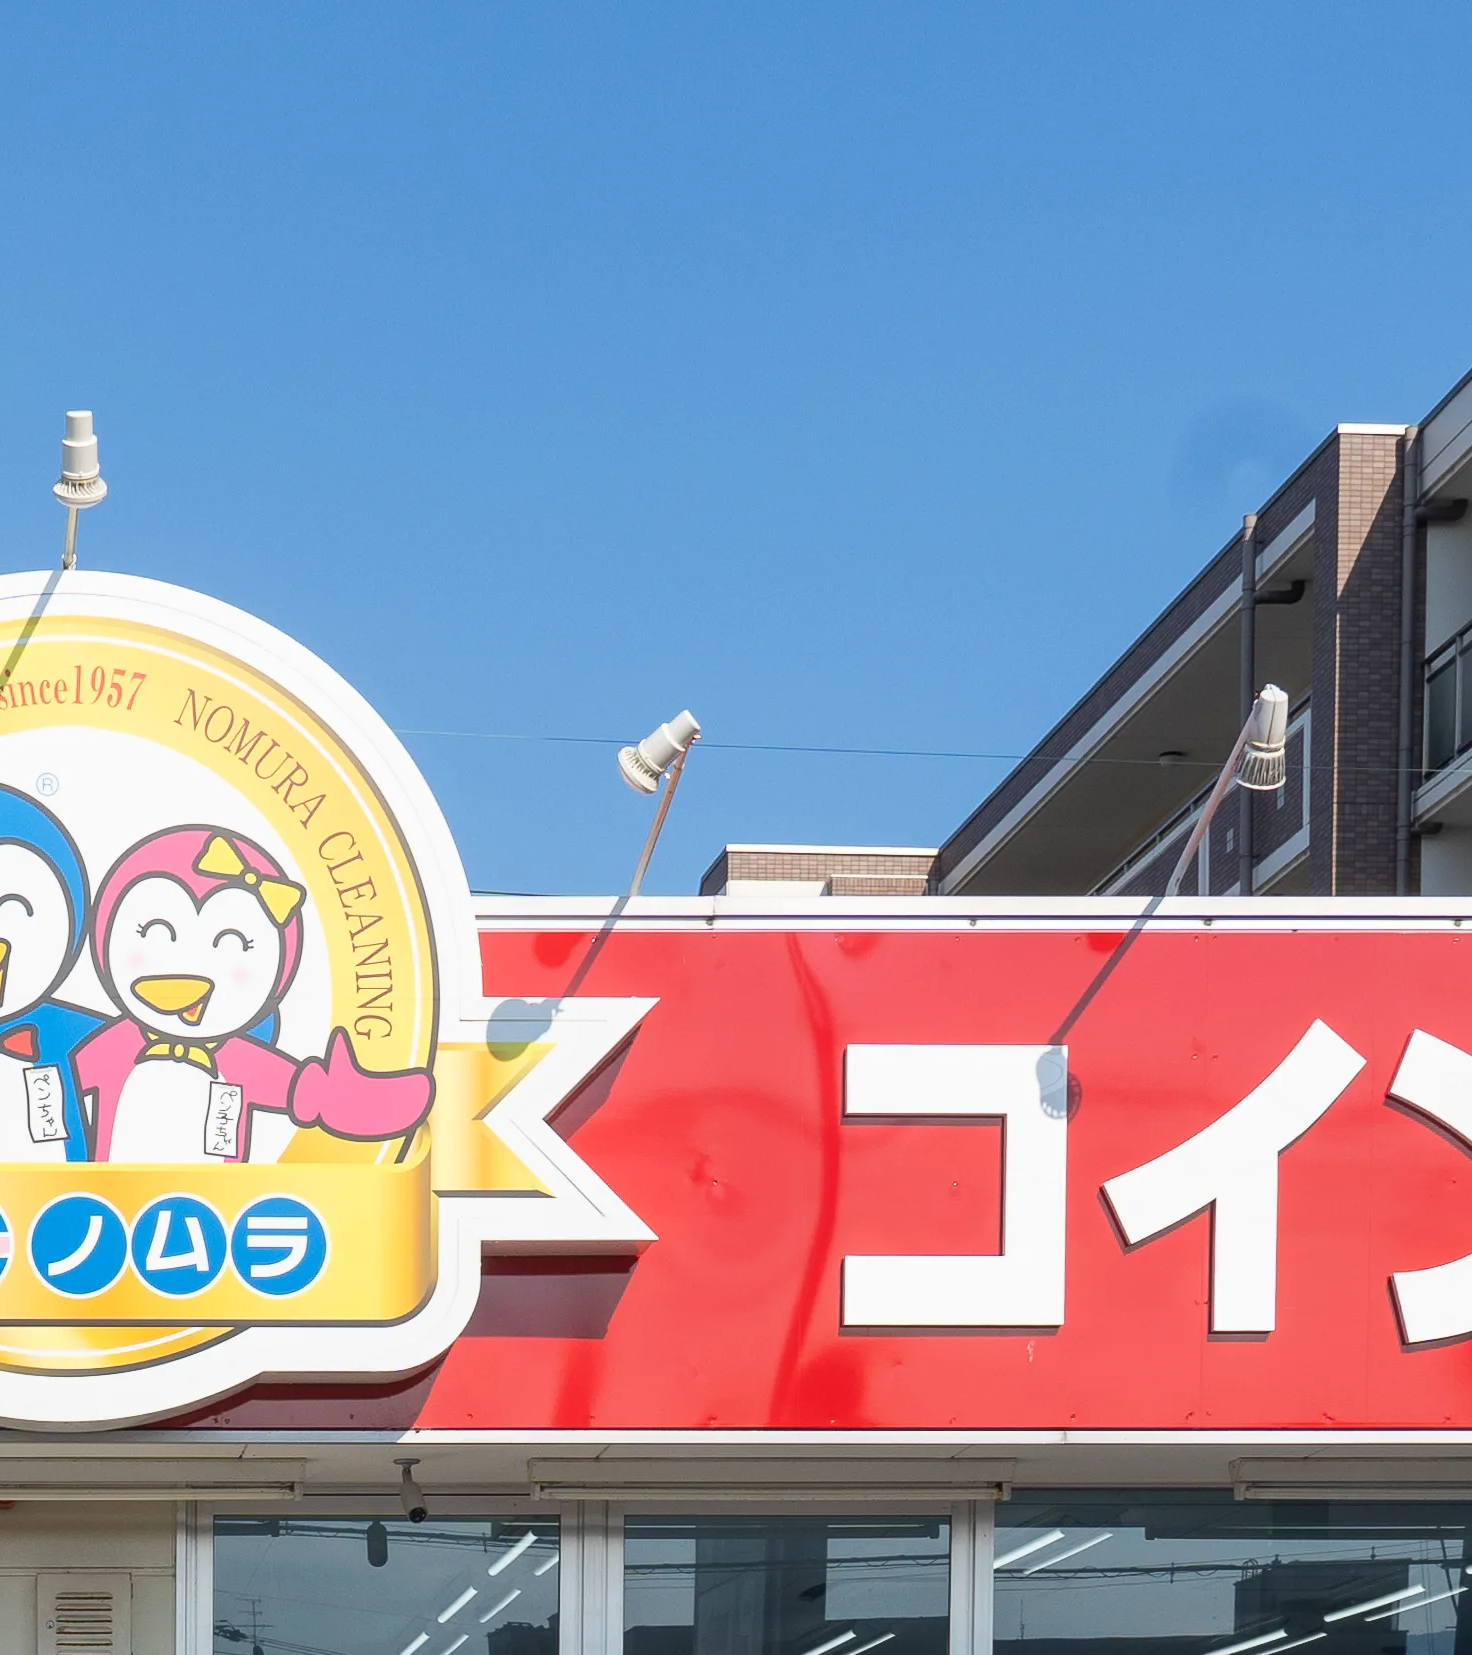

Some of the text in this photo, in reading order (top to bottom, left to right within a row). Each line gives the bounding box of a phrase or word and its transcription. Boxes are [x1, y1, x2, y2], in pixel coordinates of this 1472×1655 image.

[174, 686, 396, 1042] NOMURA CLEANING
[32, 1193, 328, 1296] ノムラ
